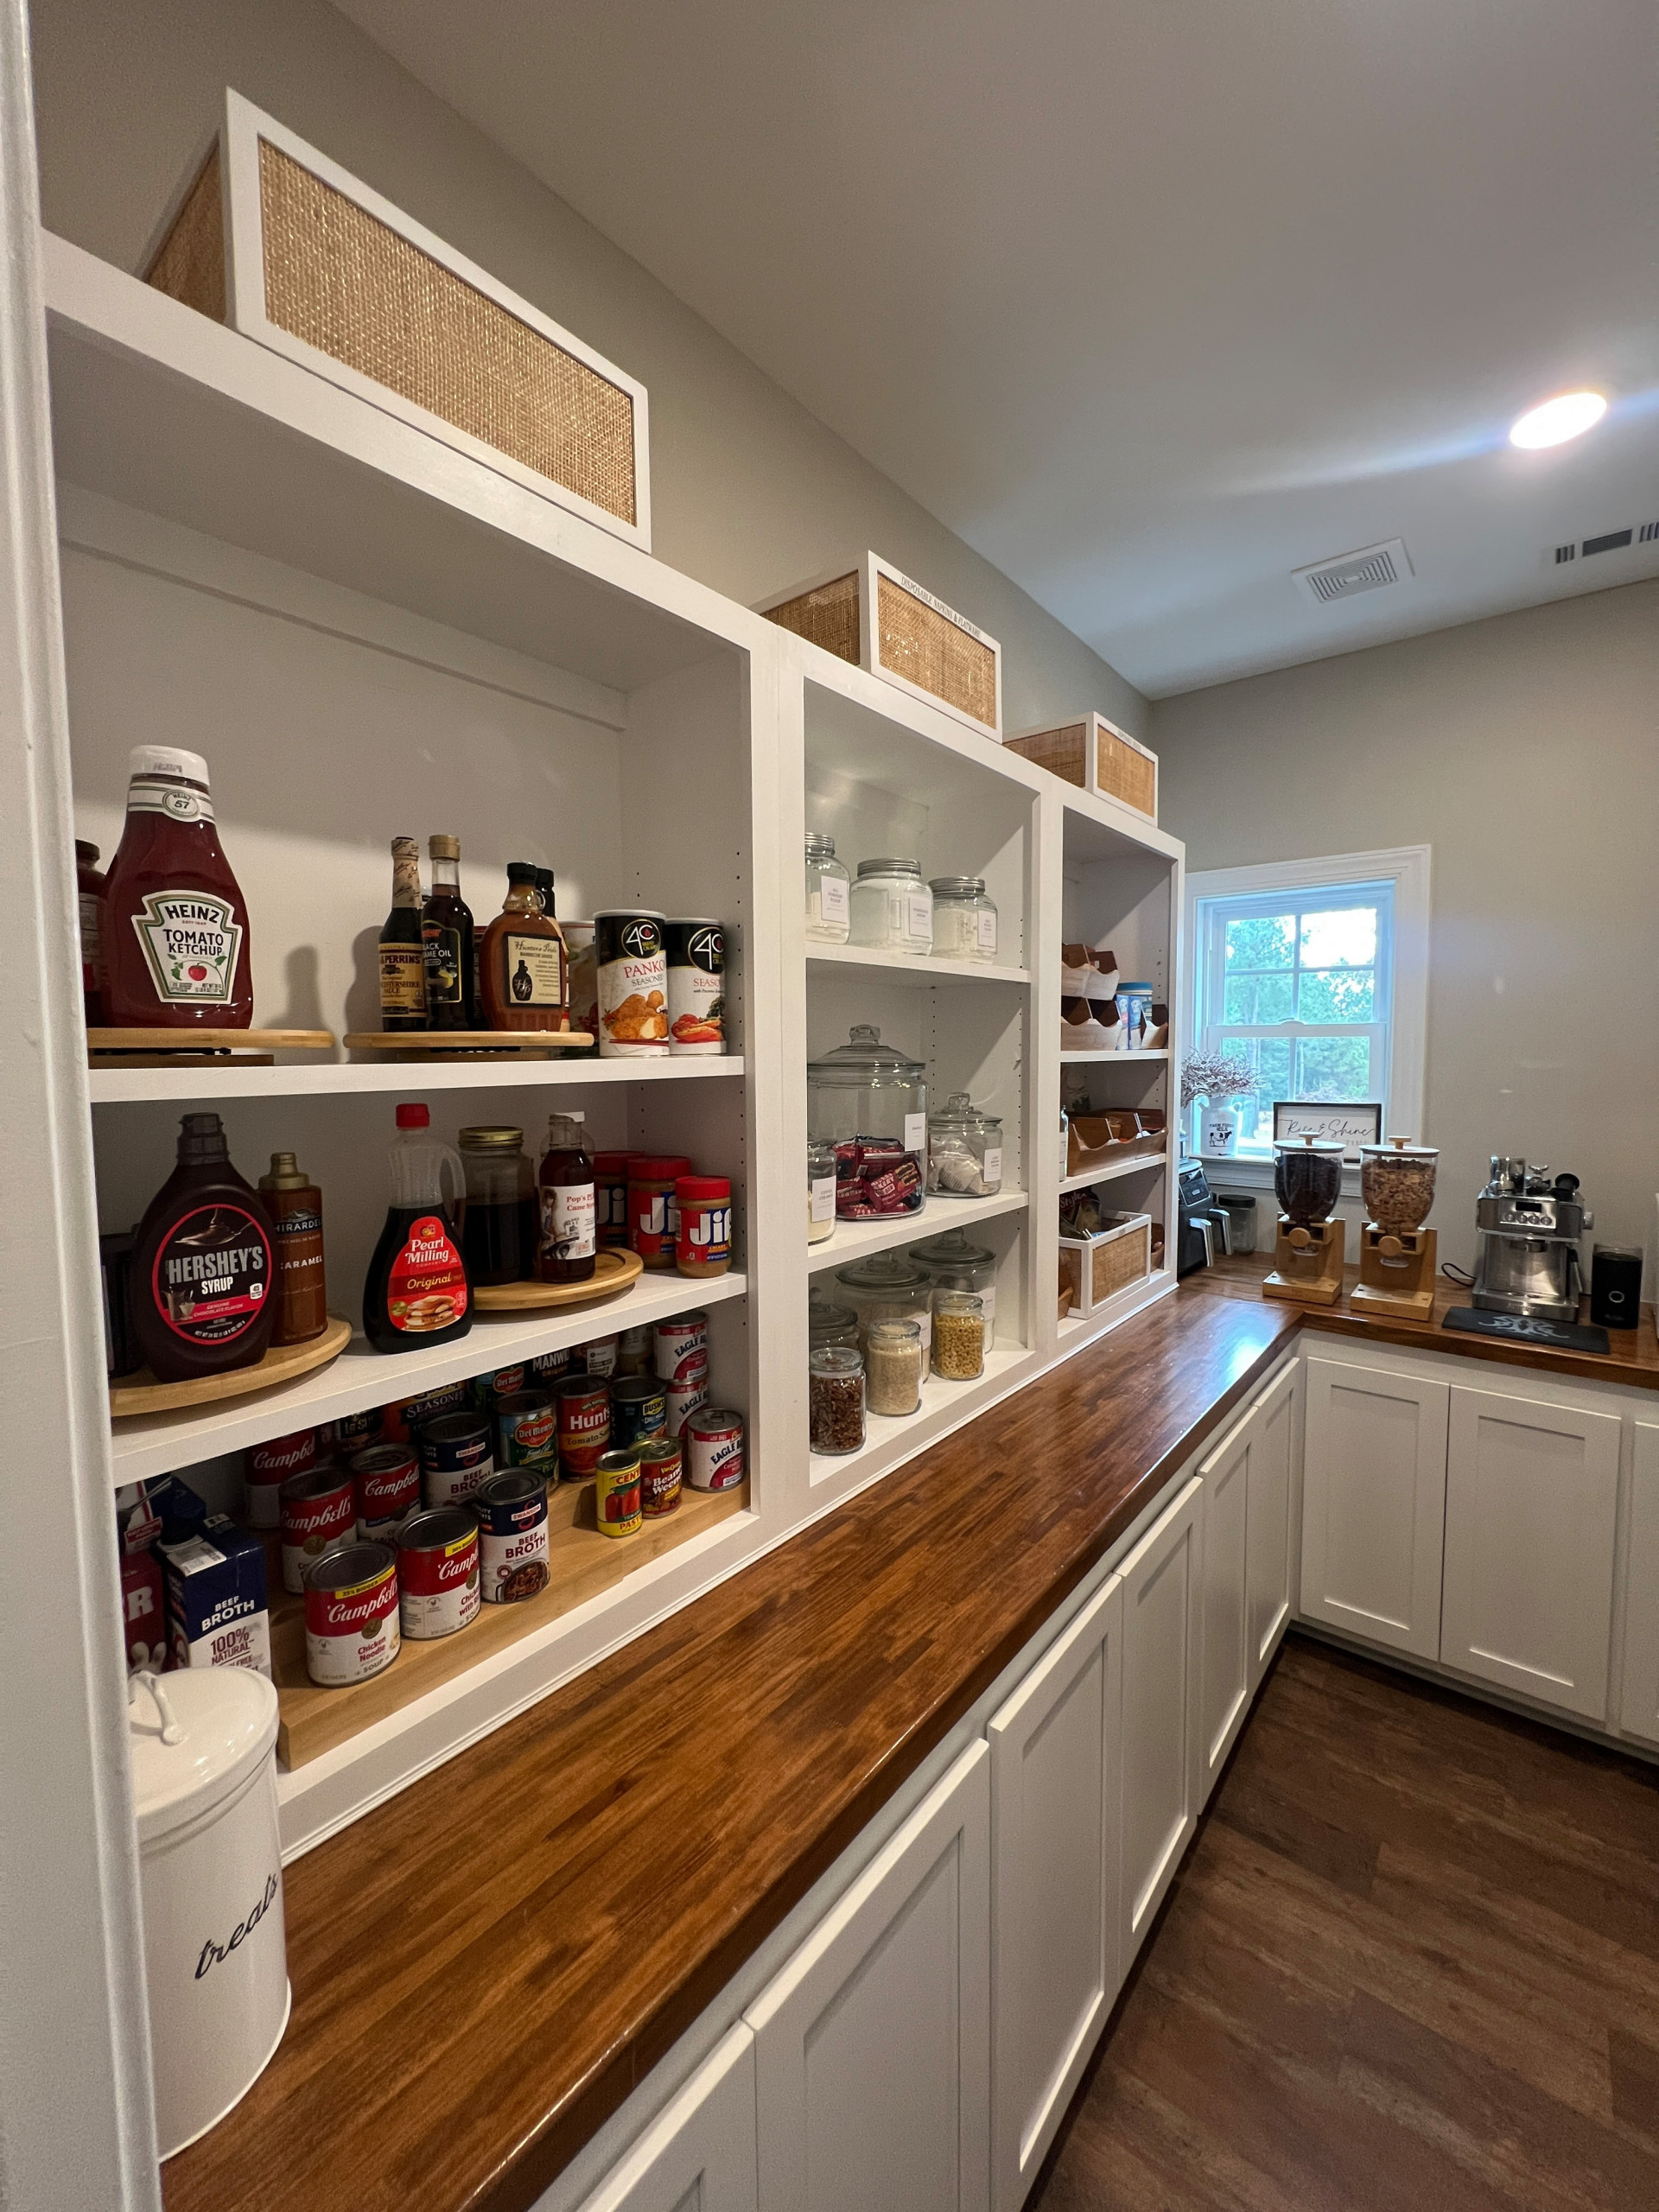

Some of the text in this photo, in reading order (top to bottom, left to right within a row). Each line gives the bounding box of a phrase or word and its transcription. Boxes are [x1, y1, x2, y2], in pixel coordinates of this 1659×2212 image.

[172, 791, 192, 801] HEINZ
[174, 799, 190, 810] 57
[164, 904, 220, 924] HEINZ
[162, 929, 225, 946] TOMATO
[625, 924, 656, 956] 4C
[168, 943, 223, 957] KETCHUP
[438, 949, 452, 957] OIL
[693, 932, 724, 970] 4C
[385, 955, 421, 964] PERRINS
[623, 959, 665, 979] PANKO
[1328, 1118, 1376, 1139] Shine
[566, 1195, 587, 1204] Pop's
[689, 1206, 733, 1246] Jif
[411, 1236, 445, 1252] Pearl
[168, 1245, 264, 1285] HERSHEY'S
[404, 1249, 450, 1265] Milling
[200, 1275, 234, 1295] SYRUP
[406, 1271, 452, 1290] Original
[193, 1303, 245, 1318] CHOCOLATE FLAVOR
[674, 1337, 699, 1357] EAGLE
[644, 1398, 664, 1414] BUSH'S
[679, 1393, 702, 1414] EAGLE
[518, 1429, 532, 1439] Del
[566, 1434, 599, 1446] Tomato
[709, 1441, 736, 1465] EAGLE
[450, 1471, 492, 1495] BRO
[463, 1468, 483, 1482] BEEF
[281, 1494, 352, 1534] Campbell's
[512, 1504, 542, 1521] SWANSON
[505, 1532, 546, 1560] BROTH
[518, 1530, 539, 1546] BEEF
[355, 1580, 379, 1594] BIGGER
[214, 1595, 239, 1613] BEEF
[200, 1599, 256, 1633] BROTH
[210, 1625, 250, 1656] 100%
[358, 1636, 386, 1656] Chicken
[212, 1640, 251, 1668] NATURAL
[235, 1654, 253, 1667] FREE
[359, 1644, 386, 1662] Noodle
[363, 1657, 385, 1675] SOUP
[194, 1873, 279, 1980] treats
